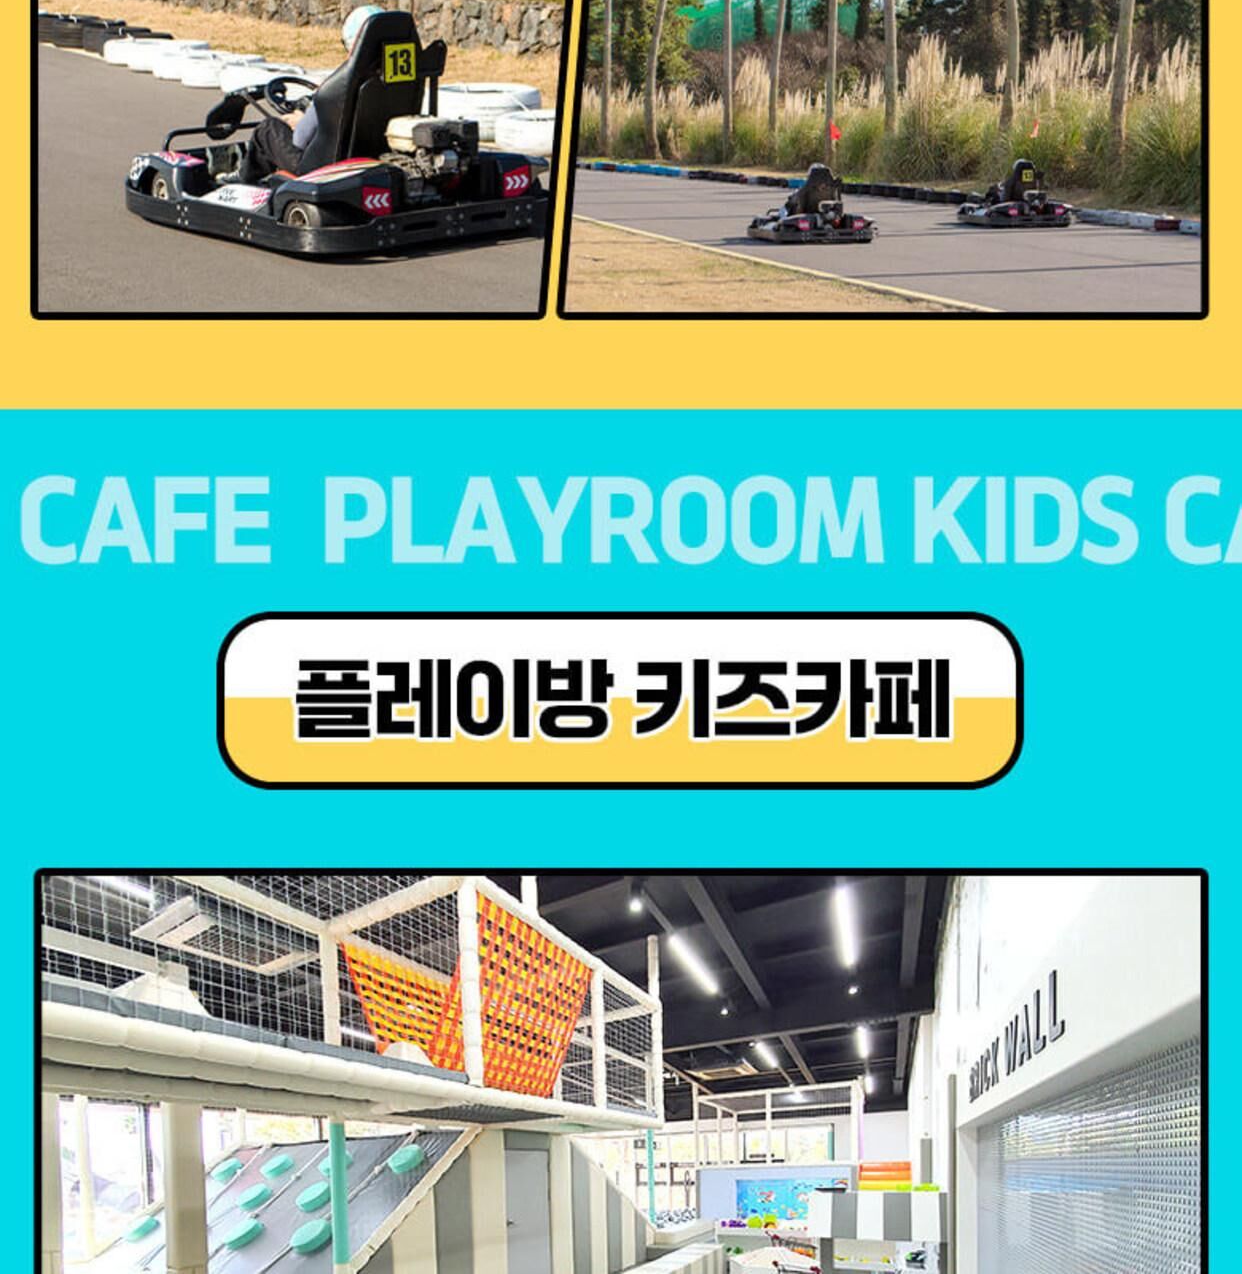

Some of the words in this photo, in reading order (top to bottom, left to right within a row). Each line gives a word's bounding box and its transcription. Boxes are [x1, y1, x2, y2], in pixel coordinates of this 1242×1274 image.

[389, 49, 412, 76] 13
[969, 1035, 1000, 1103] BRICK
[1005, 969, 1065, 1076] WALL
